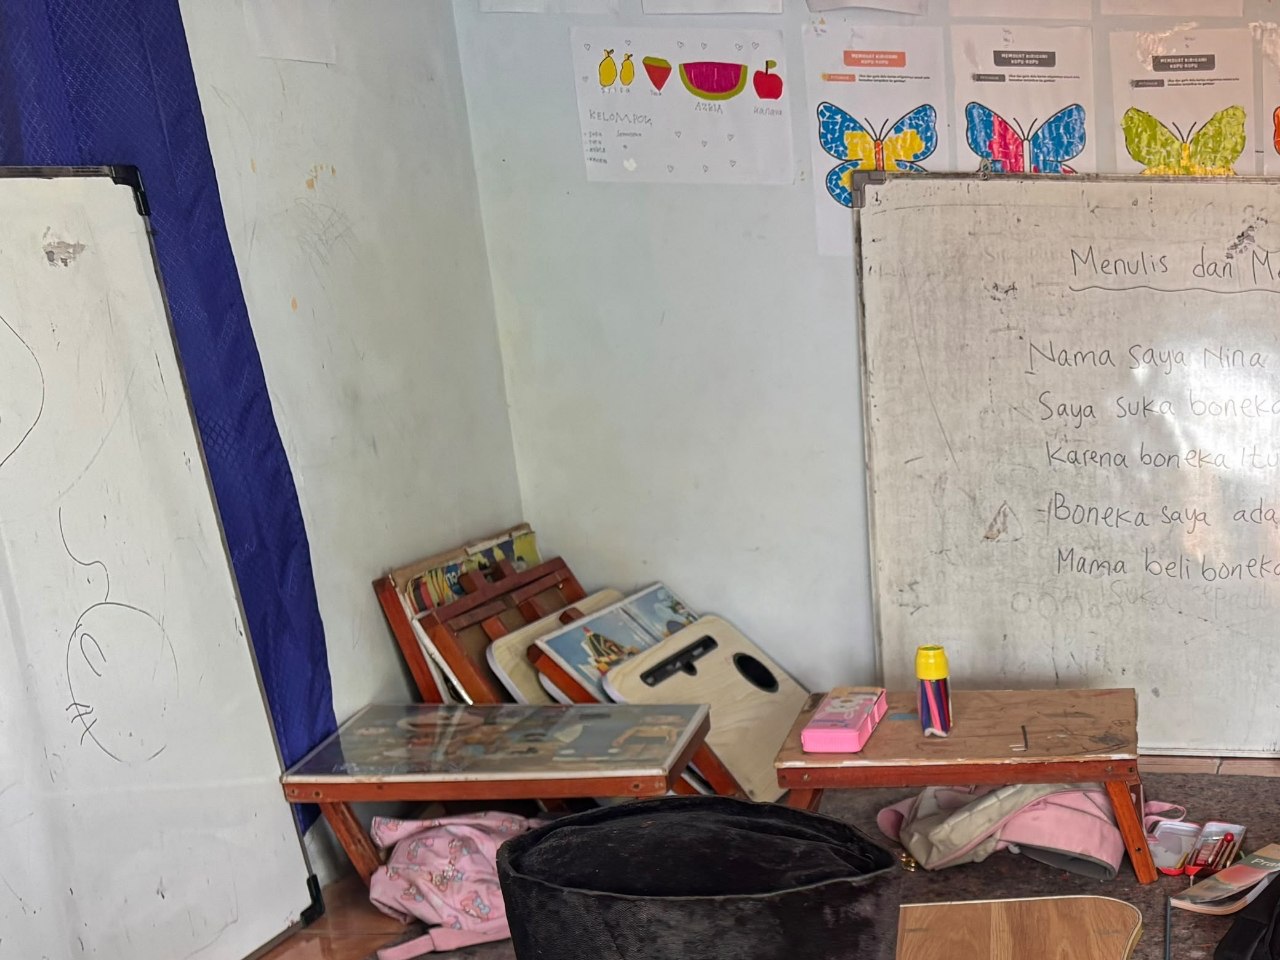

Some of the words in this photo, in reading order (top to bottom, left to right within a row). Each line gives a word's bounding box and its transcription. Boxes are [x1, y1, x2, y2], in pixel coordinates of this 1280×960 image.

[1070, 244, 1169, 277] Menulis
[1192, 241, 1232, 279] dan
[1028, 340, 1116, 371] Nama
[1203, 345, 1267, 369] Nina
[1038, 390, 1097, 429] Saya
[1139, 441, 1231, 469] boneka
[1160, 504, 1212, 535] saya
[1232, 496, 1279, 526] ada
[1056, 547, 1128, 576] Mama
[1144, 547, 1191, 579] beli
